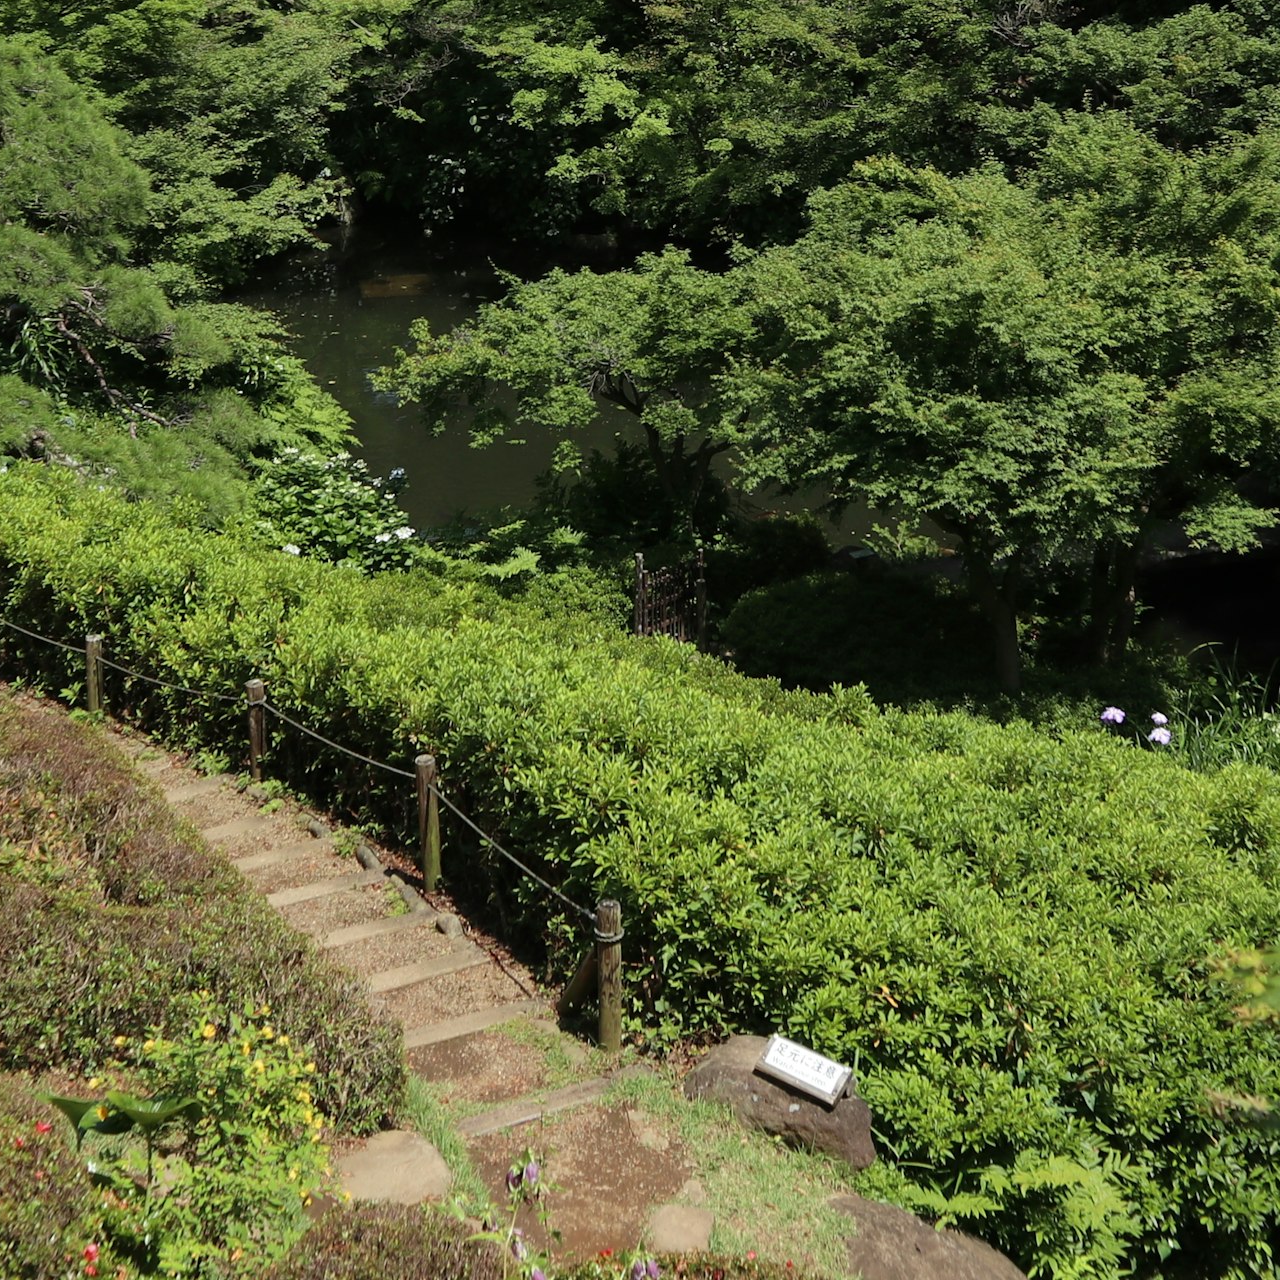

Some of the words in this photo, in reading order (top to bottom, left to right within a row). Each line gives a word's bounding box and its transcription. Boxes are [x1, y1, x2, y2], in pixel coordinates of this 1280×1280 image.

[773, 1055, 794, 1070] Watch
[775, 1042, 836, 1080] 足元に注意
